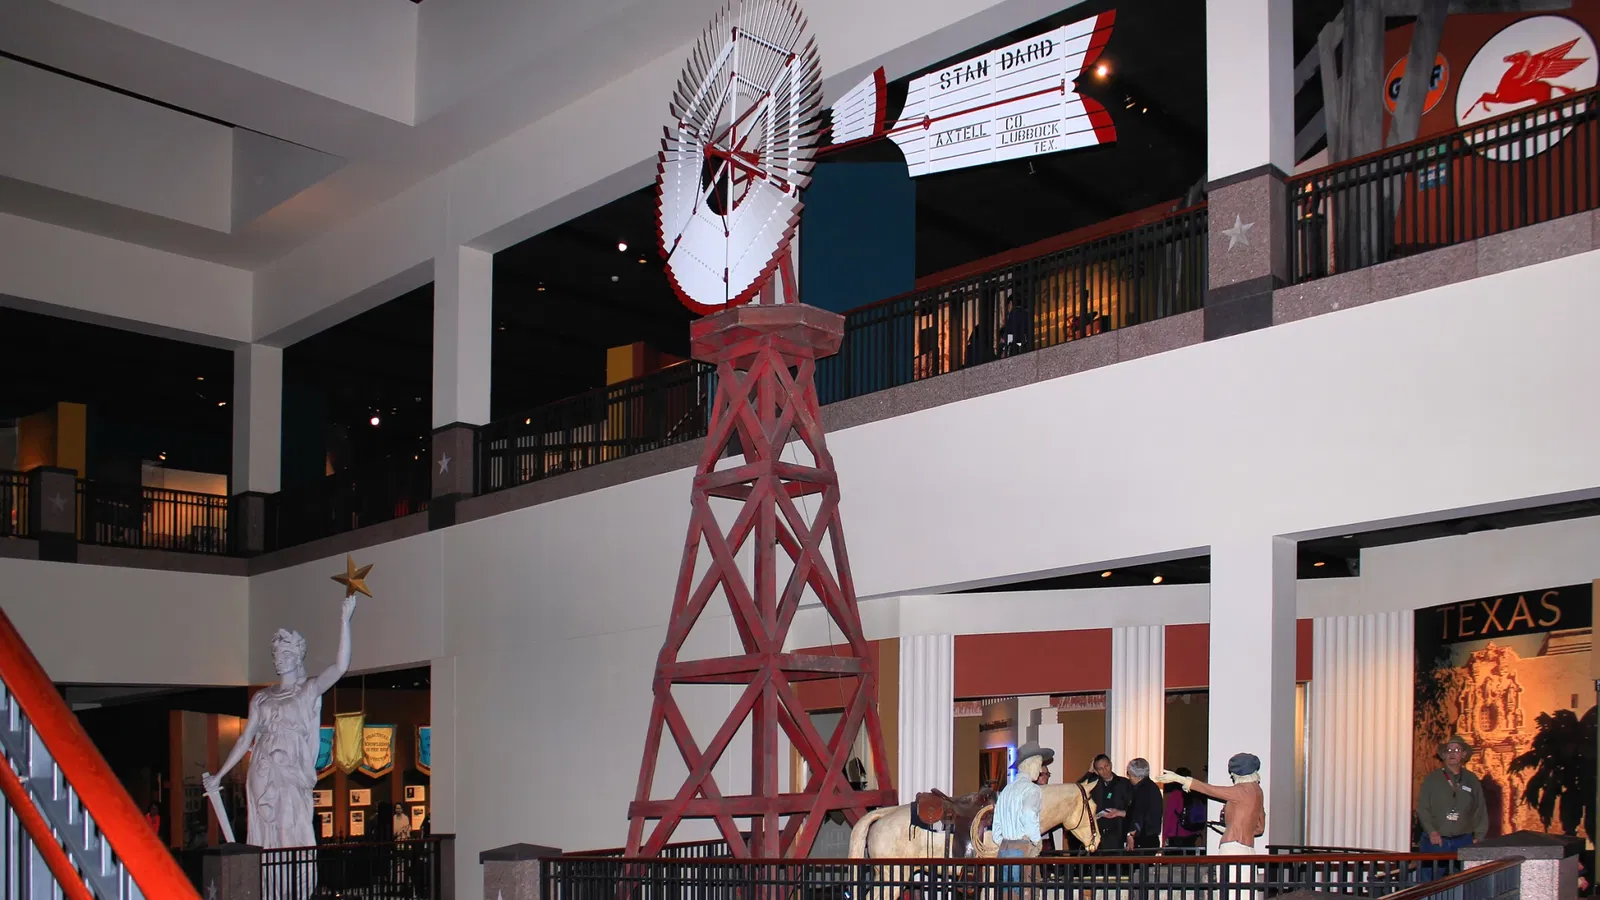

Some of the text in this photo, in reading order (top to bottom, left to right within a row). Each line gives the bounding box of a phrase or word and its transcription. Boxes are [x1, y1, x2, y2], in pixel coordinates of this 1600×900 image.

[1388, 64, 1444, 102] GF
[936, 124, 987, 147] AXTELL
[1001, 123, 1059, 144] LUBBOCK
[1034, 139, 1058, 153] TEX.
[1436, 591, 1562, 639] TEXAS
